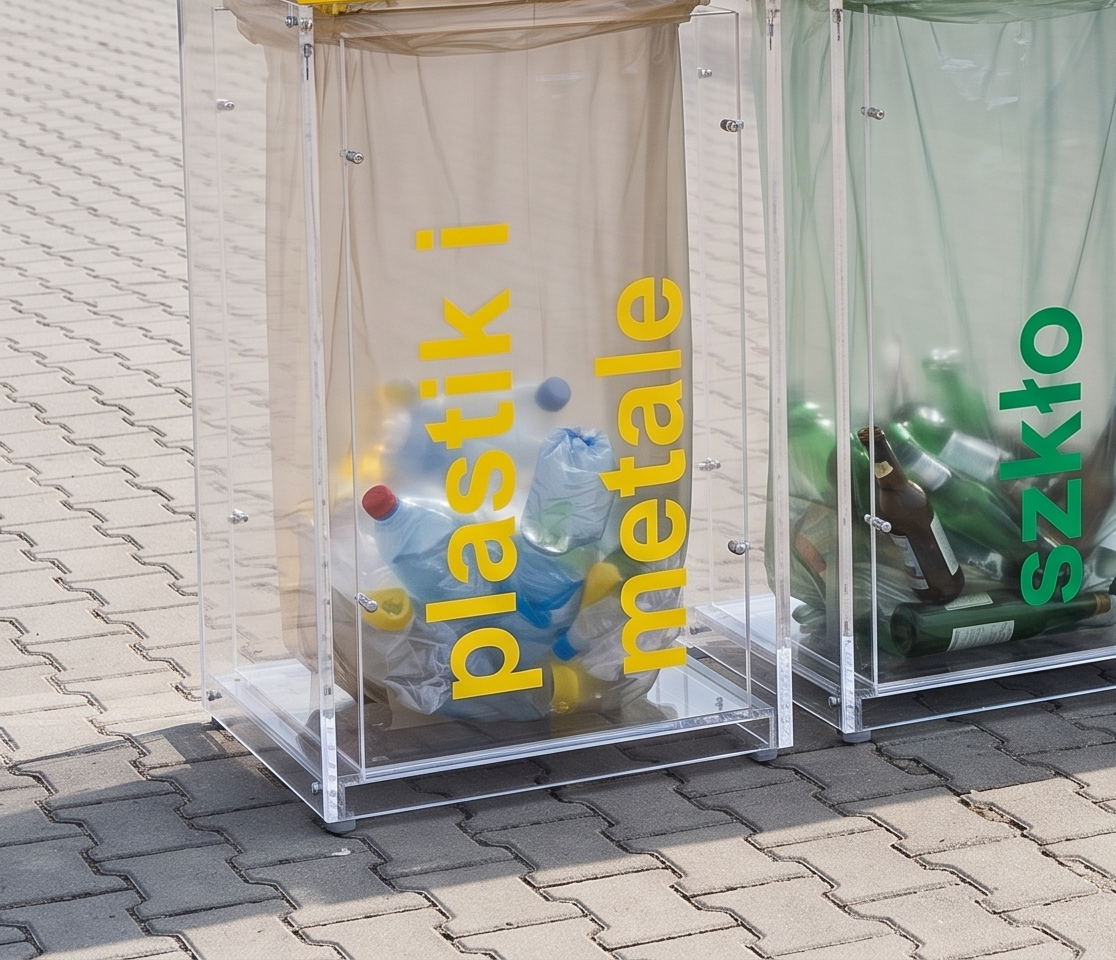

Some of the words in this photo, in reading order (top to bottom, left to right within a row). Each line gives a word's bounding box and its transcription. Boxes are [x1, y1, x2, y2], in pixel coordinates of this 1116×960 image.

[415, 222, 510, 251] i
[418, 287, 543, 701] plastik
[594, 276, 688, 675] metale
[999, 306, 1084, 606] szkło
